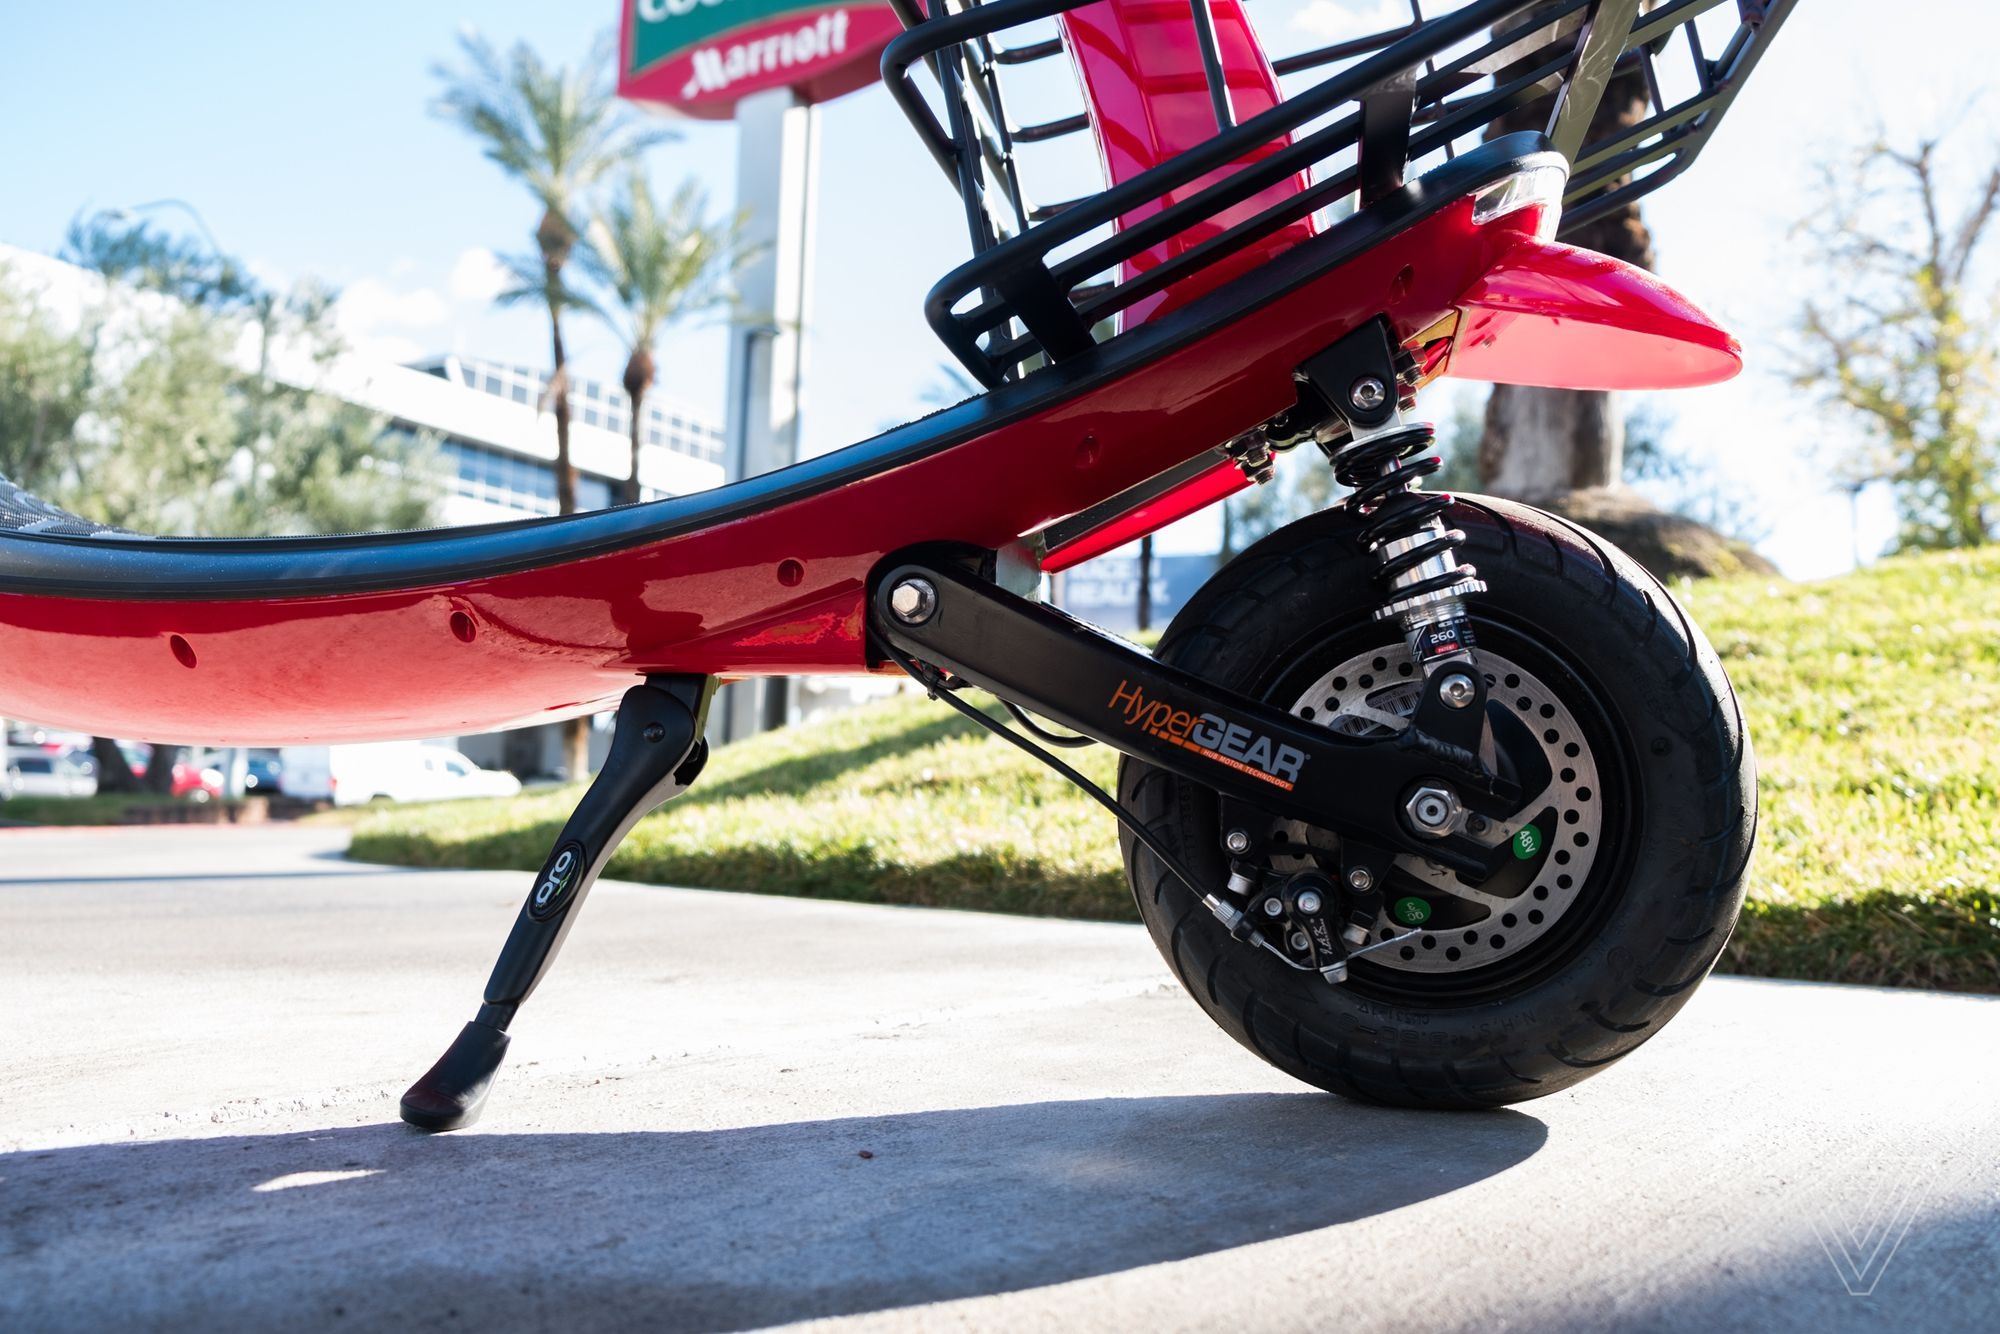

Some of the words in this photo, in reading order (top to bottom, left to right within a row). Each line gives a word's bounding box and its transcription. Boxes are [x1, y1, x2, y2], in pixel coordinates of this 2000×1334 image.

[681, 9, 849, 99] Marriott
[1429, 629, 1456, 644] 260
[1203, 749, 1219, 760] HUB
[1220, 755, 1244, 771] MOTOR
[1244, 765, 1290, 789] TECHNOLOGY
[1518, 829, 1537, 854] 48V
